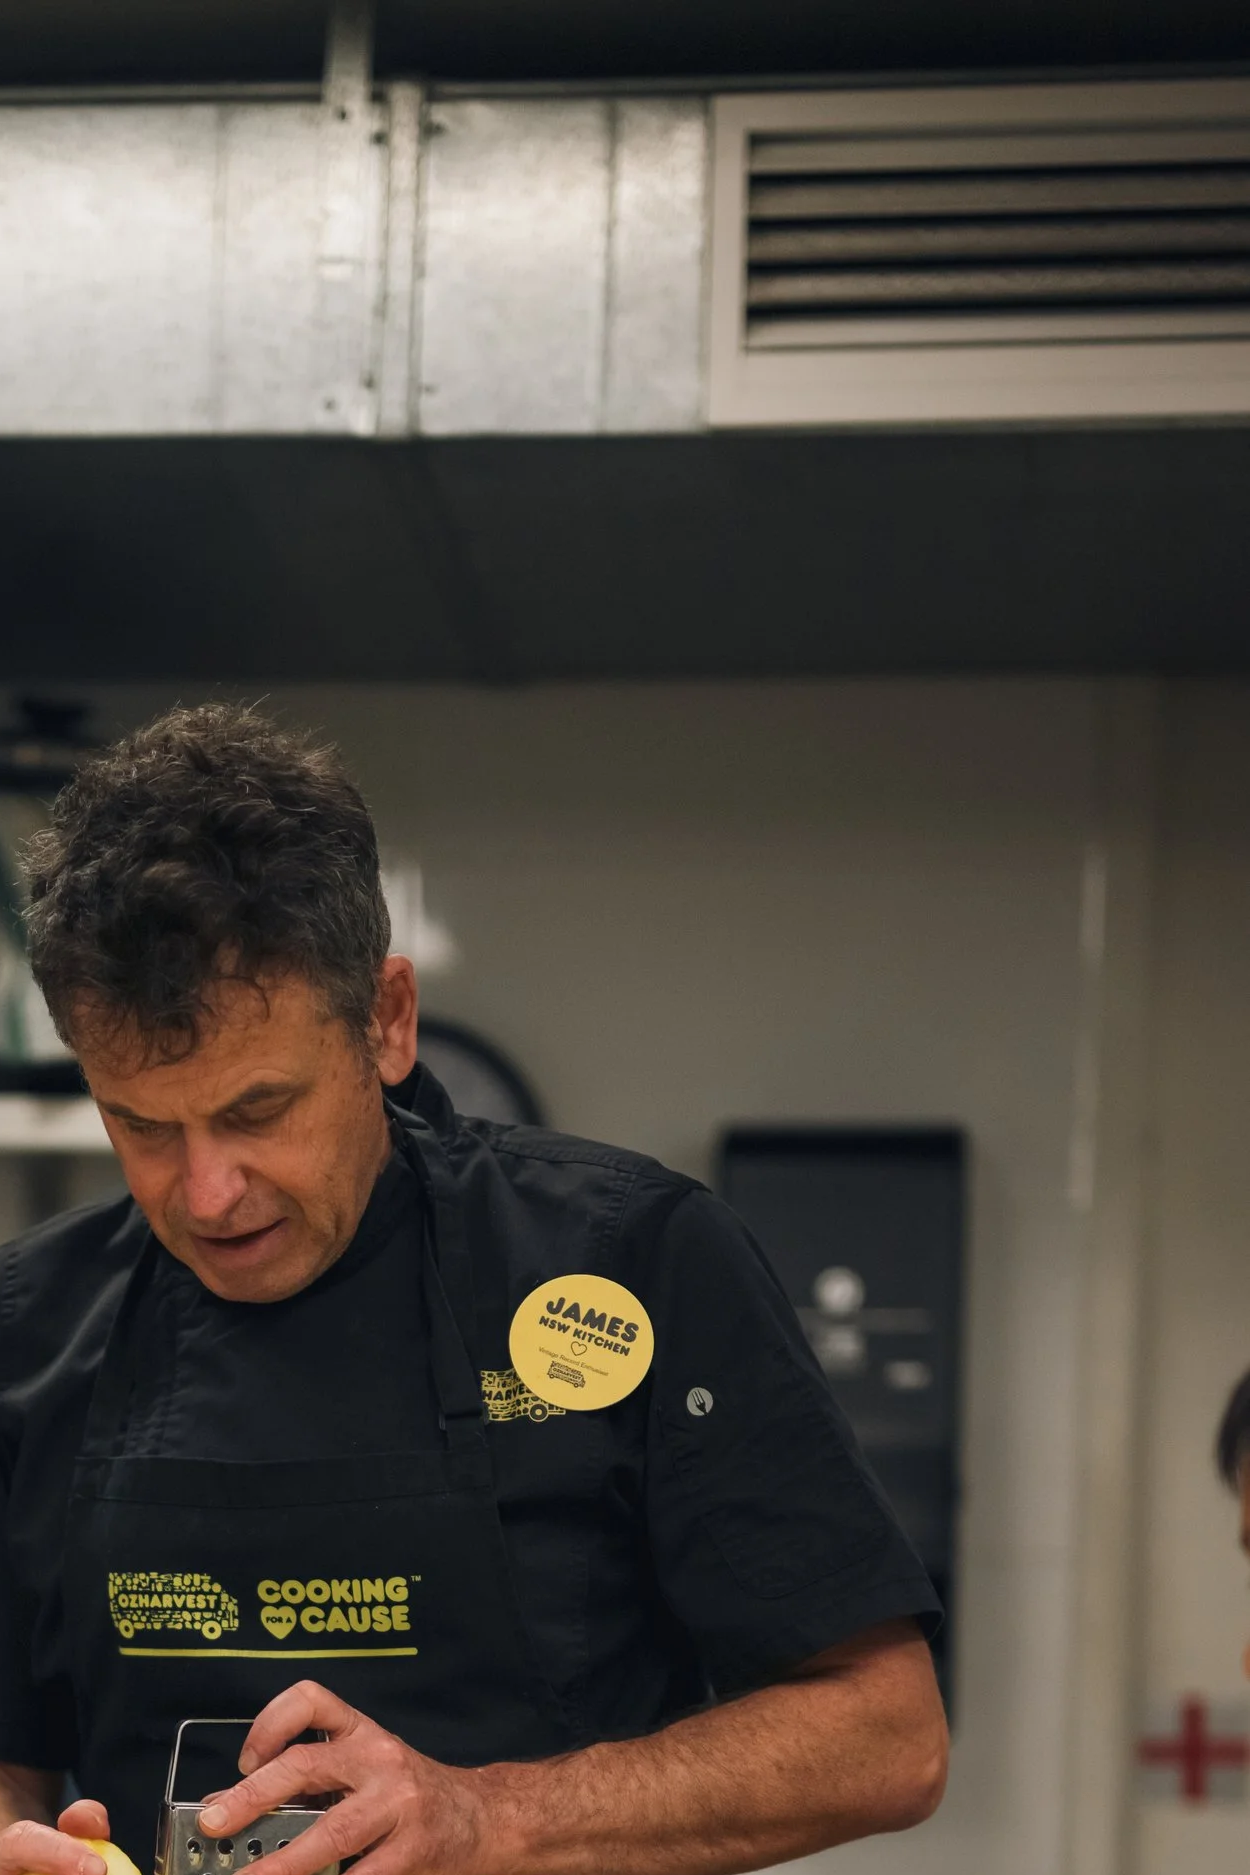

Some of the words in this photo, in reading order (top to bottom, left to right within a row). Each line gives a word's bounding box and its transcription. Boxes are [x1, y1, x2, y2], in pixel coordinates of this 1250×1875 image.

[546, 1297, 639, 1343] JAMES
[539, 1316, 571, 1334] NSW
[573, 1328, 631, 1356] KITCHEN
[482, 1384, 530, 1401] HARVE
[117, 1594, 218, 1610] OZHARVEST
[256, 1576, 409, 1605] COOKING
[265, 1616, 284, 1624] FOR
[285, 1616, 293, 1624] A
[299, 1605, 412, 1633] CAUSE
